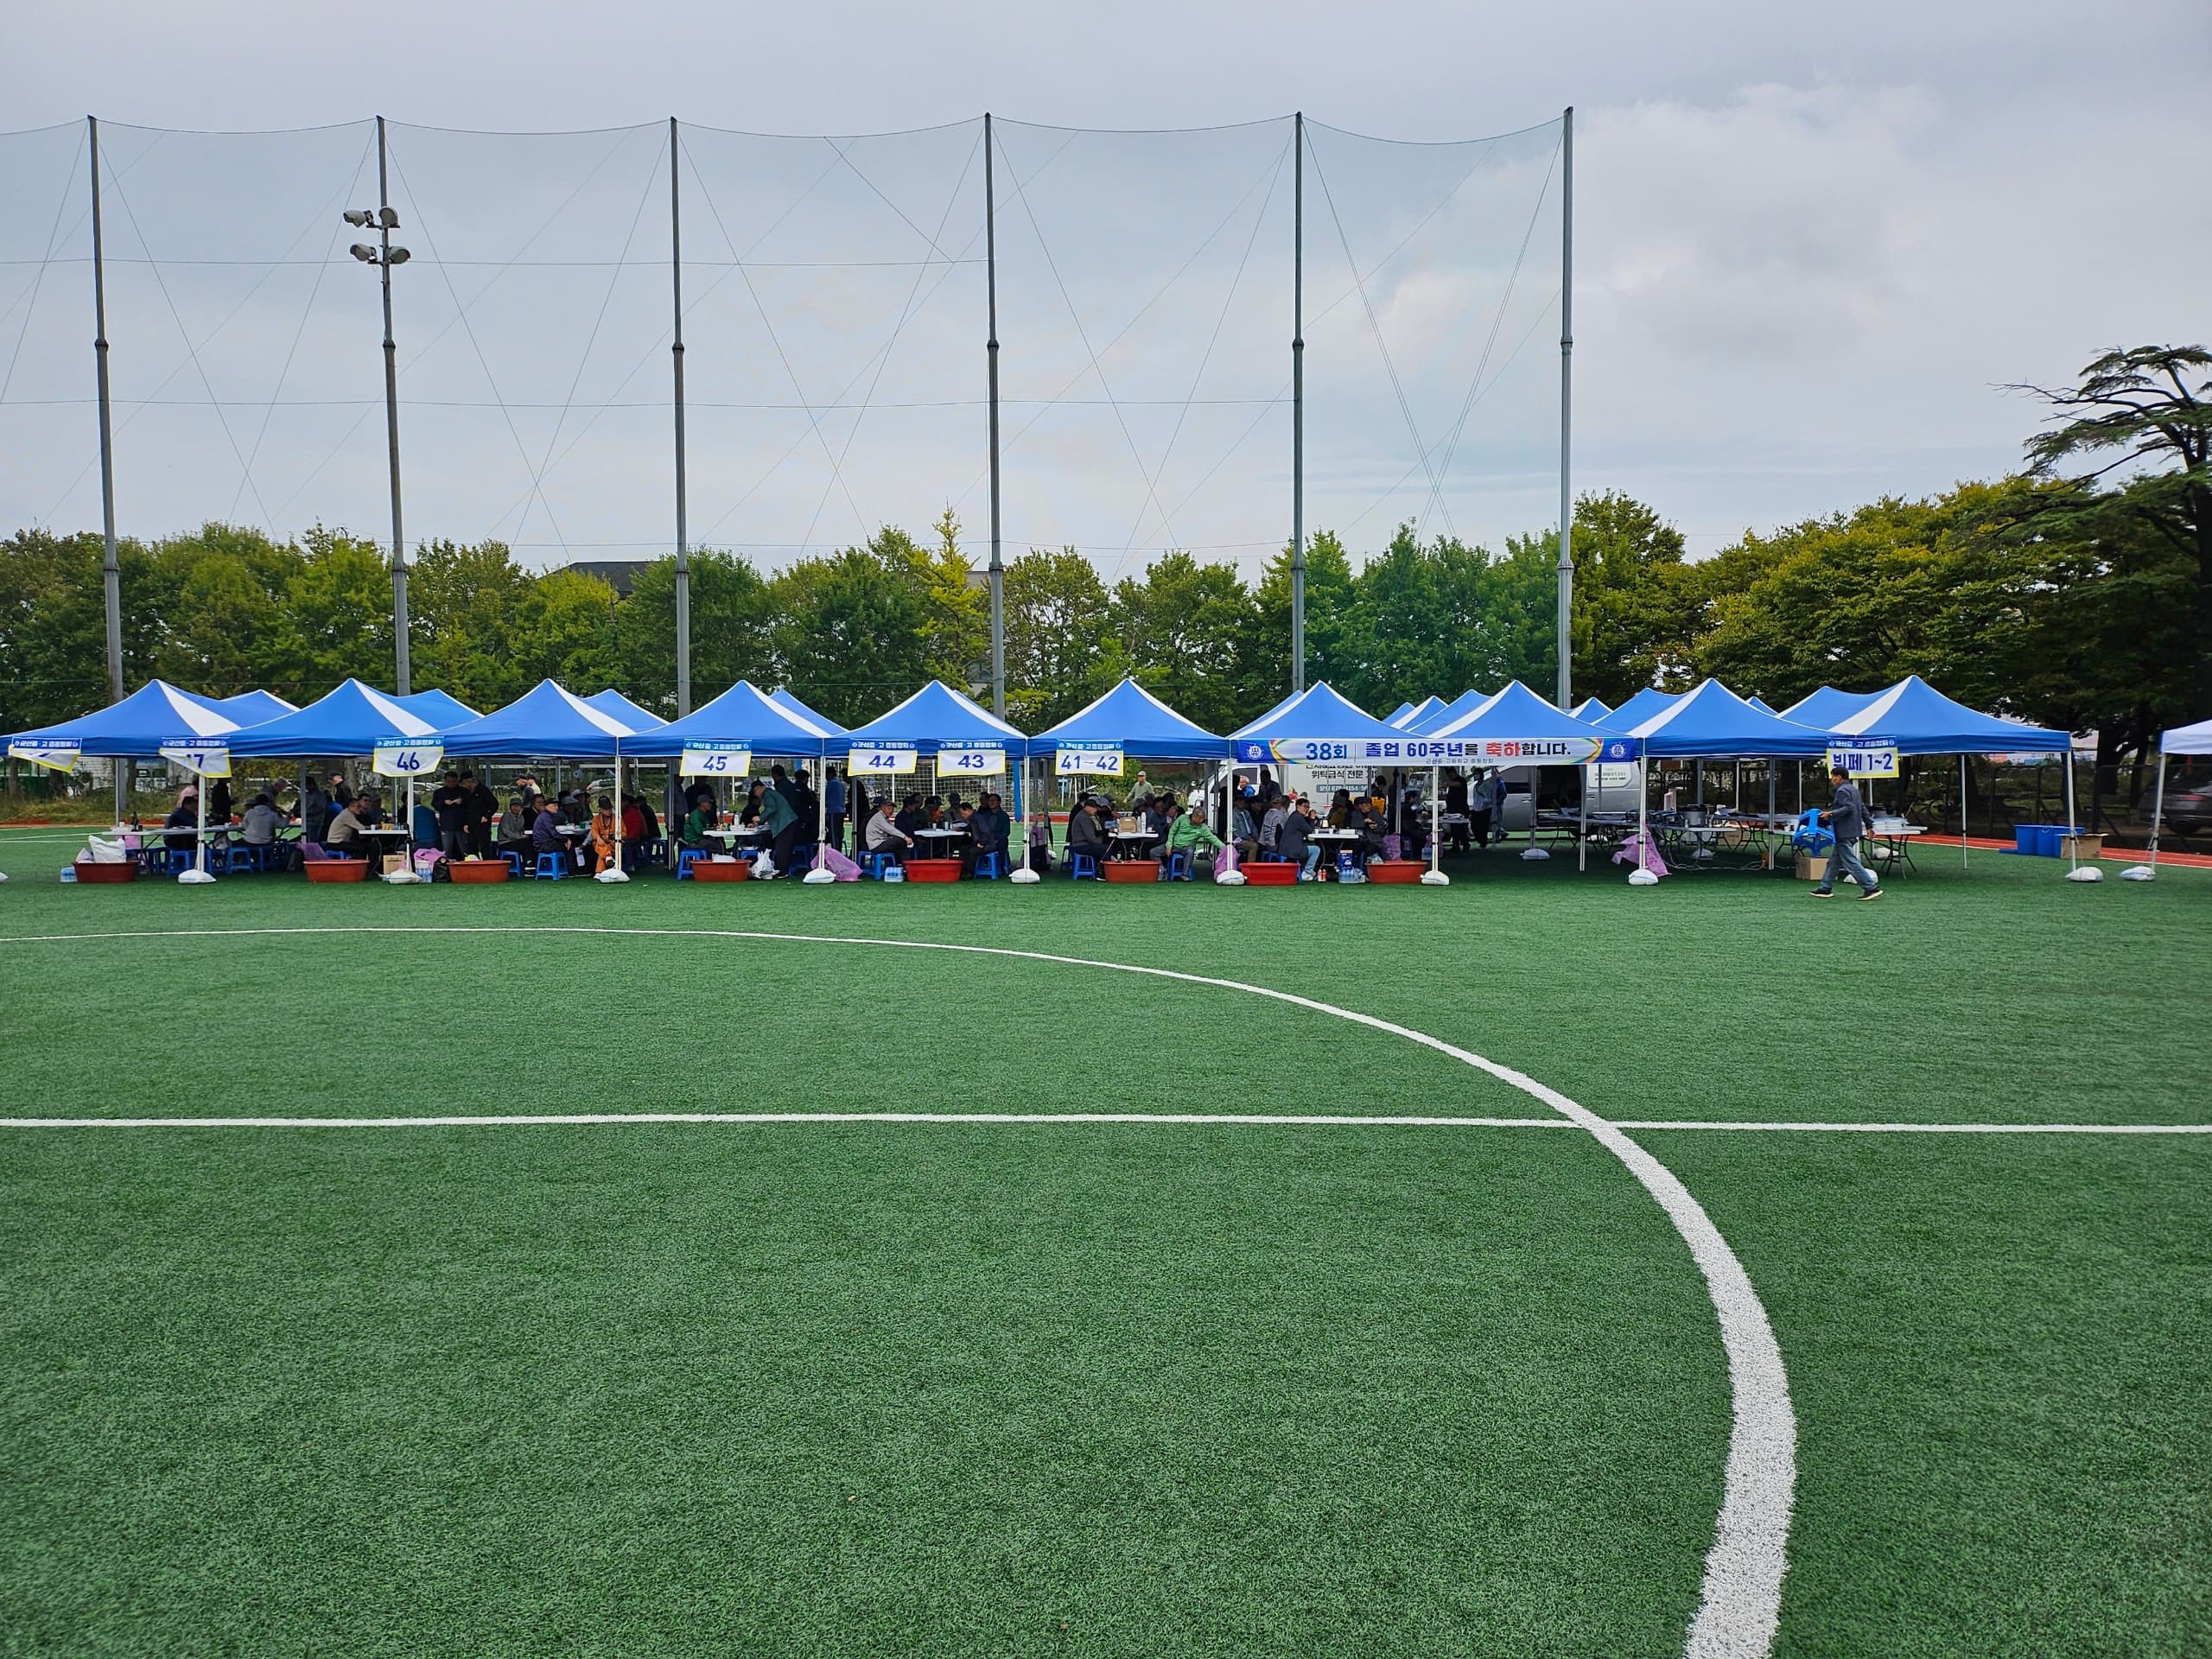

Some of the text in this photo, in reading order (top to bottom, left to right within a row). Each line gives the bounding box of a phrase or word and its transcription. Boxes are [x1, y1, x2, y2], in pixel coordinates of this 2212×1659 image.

[1306, 742, 1571, 760] 38회 졸업 60주년을 축하합니다.
[187, 753, 205, 769] 7
[397, 752, 420, 771] 46
[703, 755, 728, 771] 45
[868, 754, 896, 768] 44
[957, 754, 984, 768] 43
[1867, 753, 1893, 771] 1~2
[1312, 770, 1344, 779] 위탁급식
[1347, 770, 1363, 779] 전문
